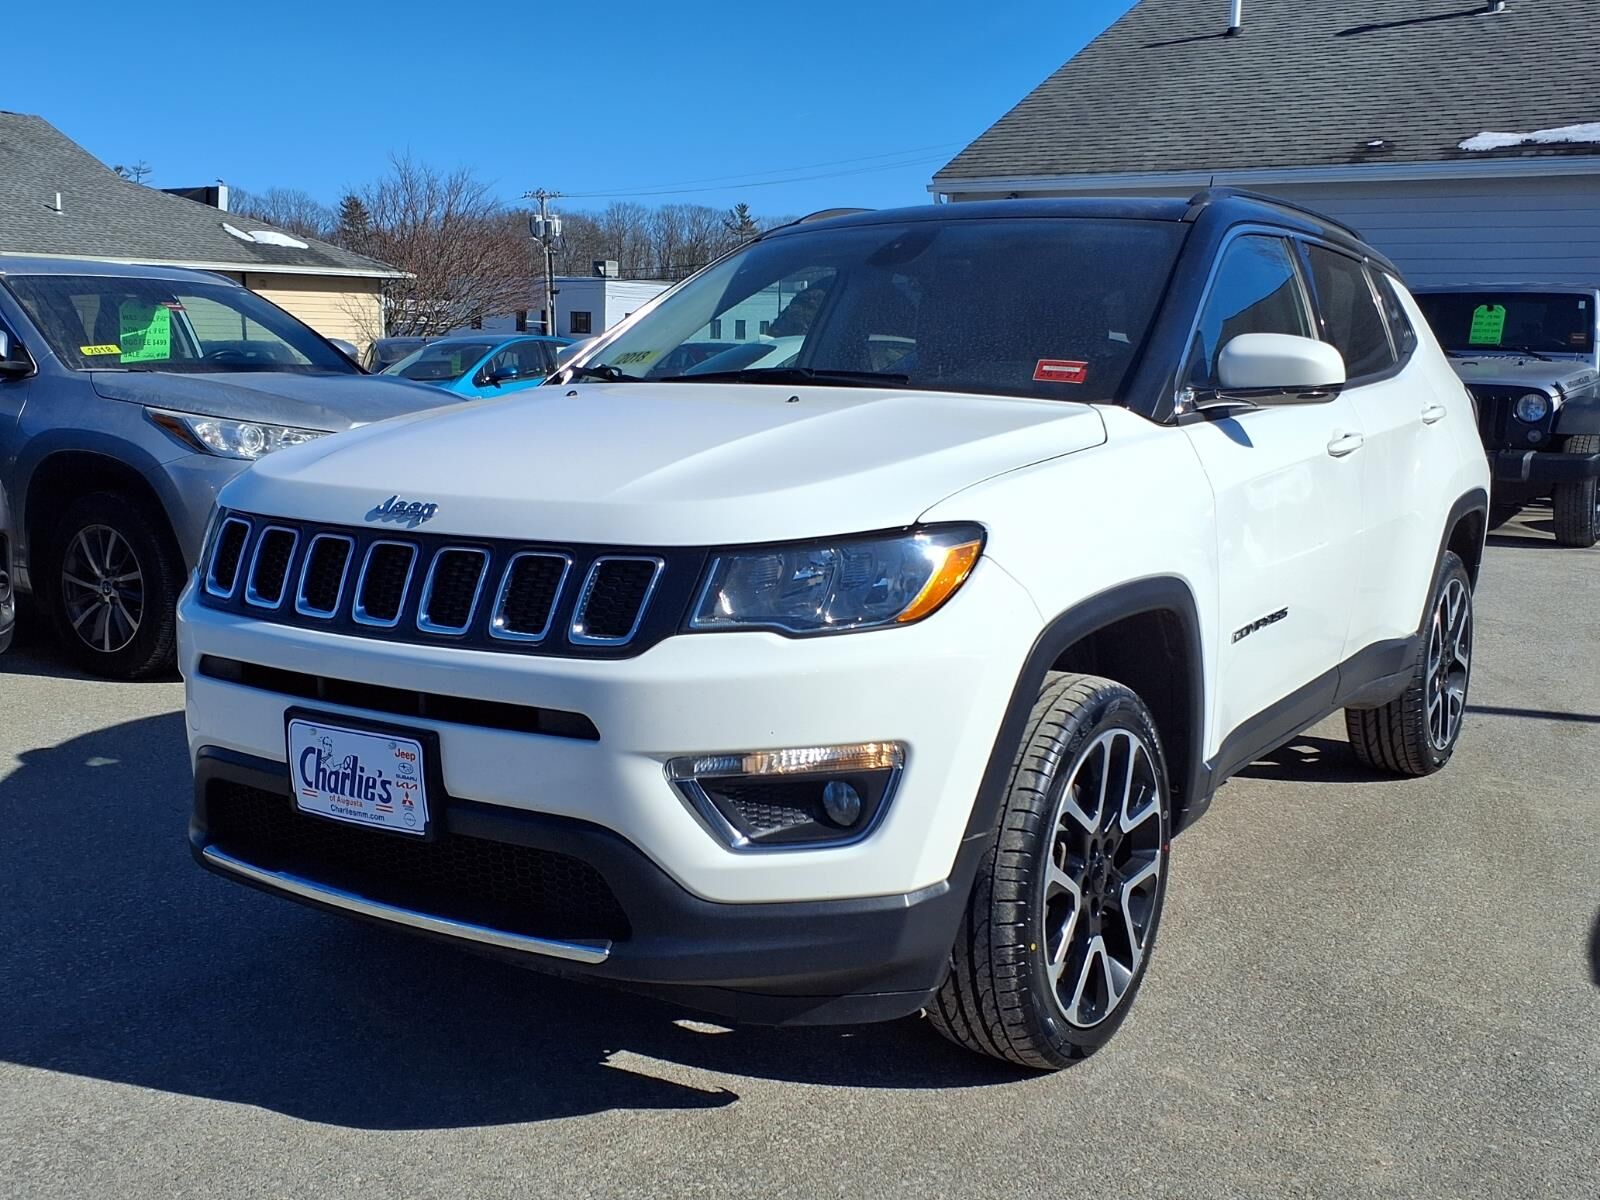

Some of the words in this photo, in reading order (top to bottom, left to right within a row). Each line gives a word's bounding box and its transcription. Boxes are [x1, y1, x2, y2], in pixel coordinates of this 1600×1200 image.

[87, 346, 114, 354] 2018
[375, 494, 439, 523] Jeep
[1230, 605, 1289, 645] COMPASS
[394, 748, 416, 762] Jeep
[299, 746, 393, 804] Charlie's
[336, 796, 363, 808] Augusta
